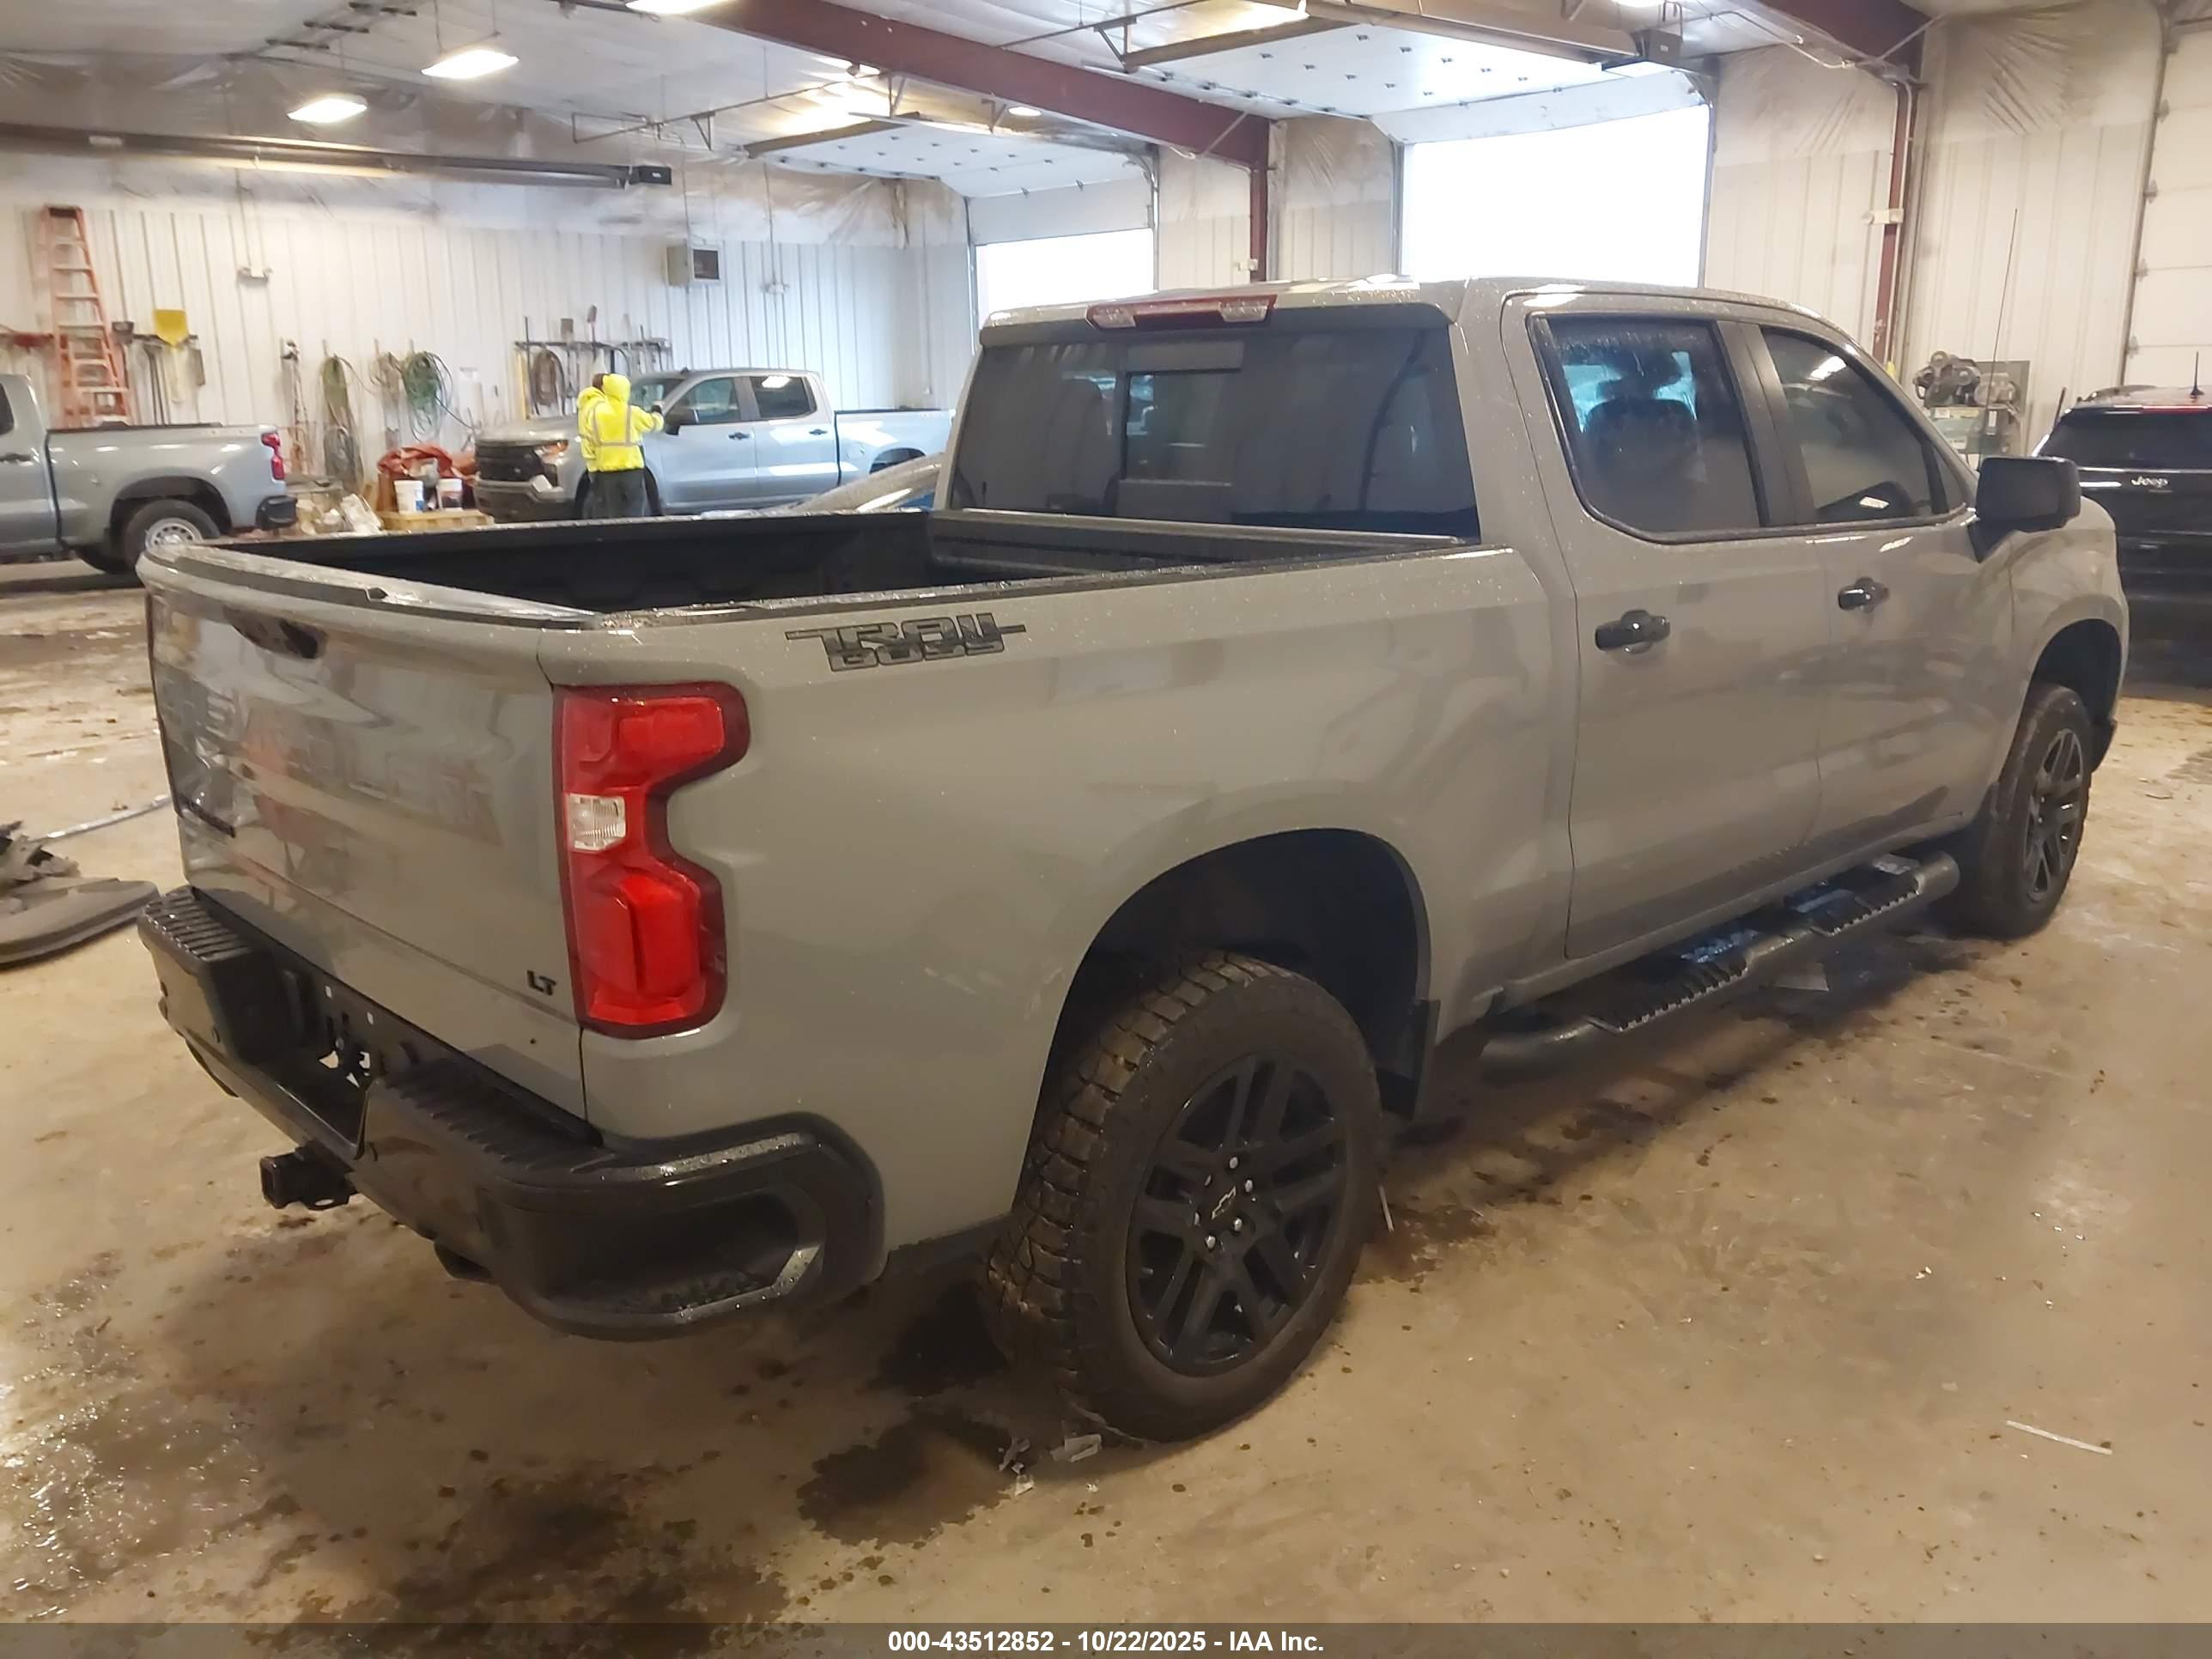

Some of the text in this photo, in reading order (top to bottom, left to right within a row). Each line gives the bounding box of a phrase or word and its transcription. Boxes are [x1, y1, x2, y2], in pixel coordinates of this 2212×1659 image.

[2130, 476, 2169, 488] Jeep
[784, 612, 1027, 656] TRAIL
[526, 969, 556, 996] LT
